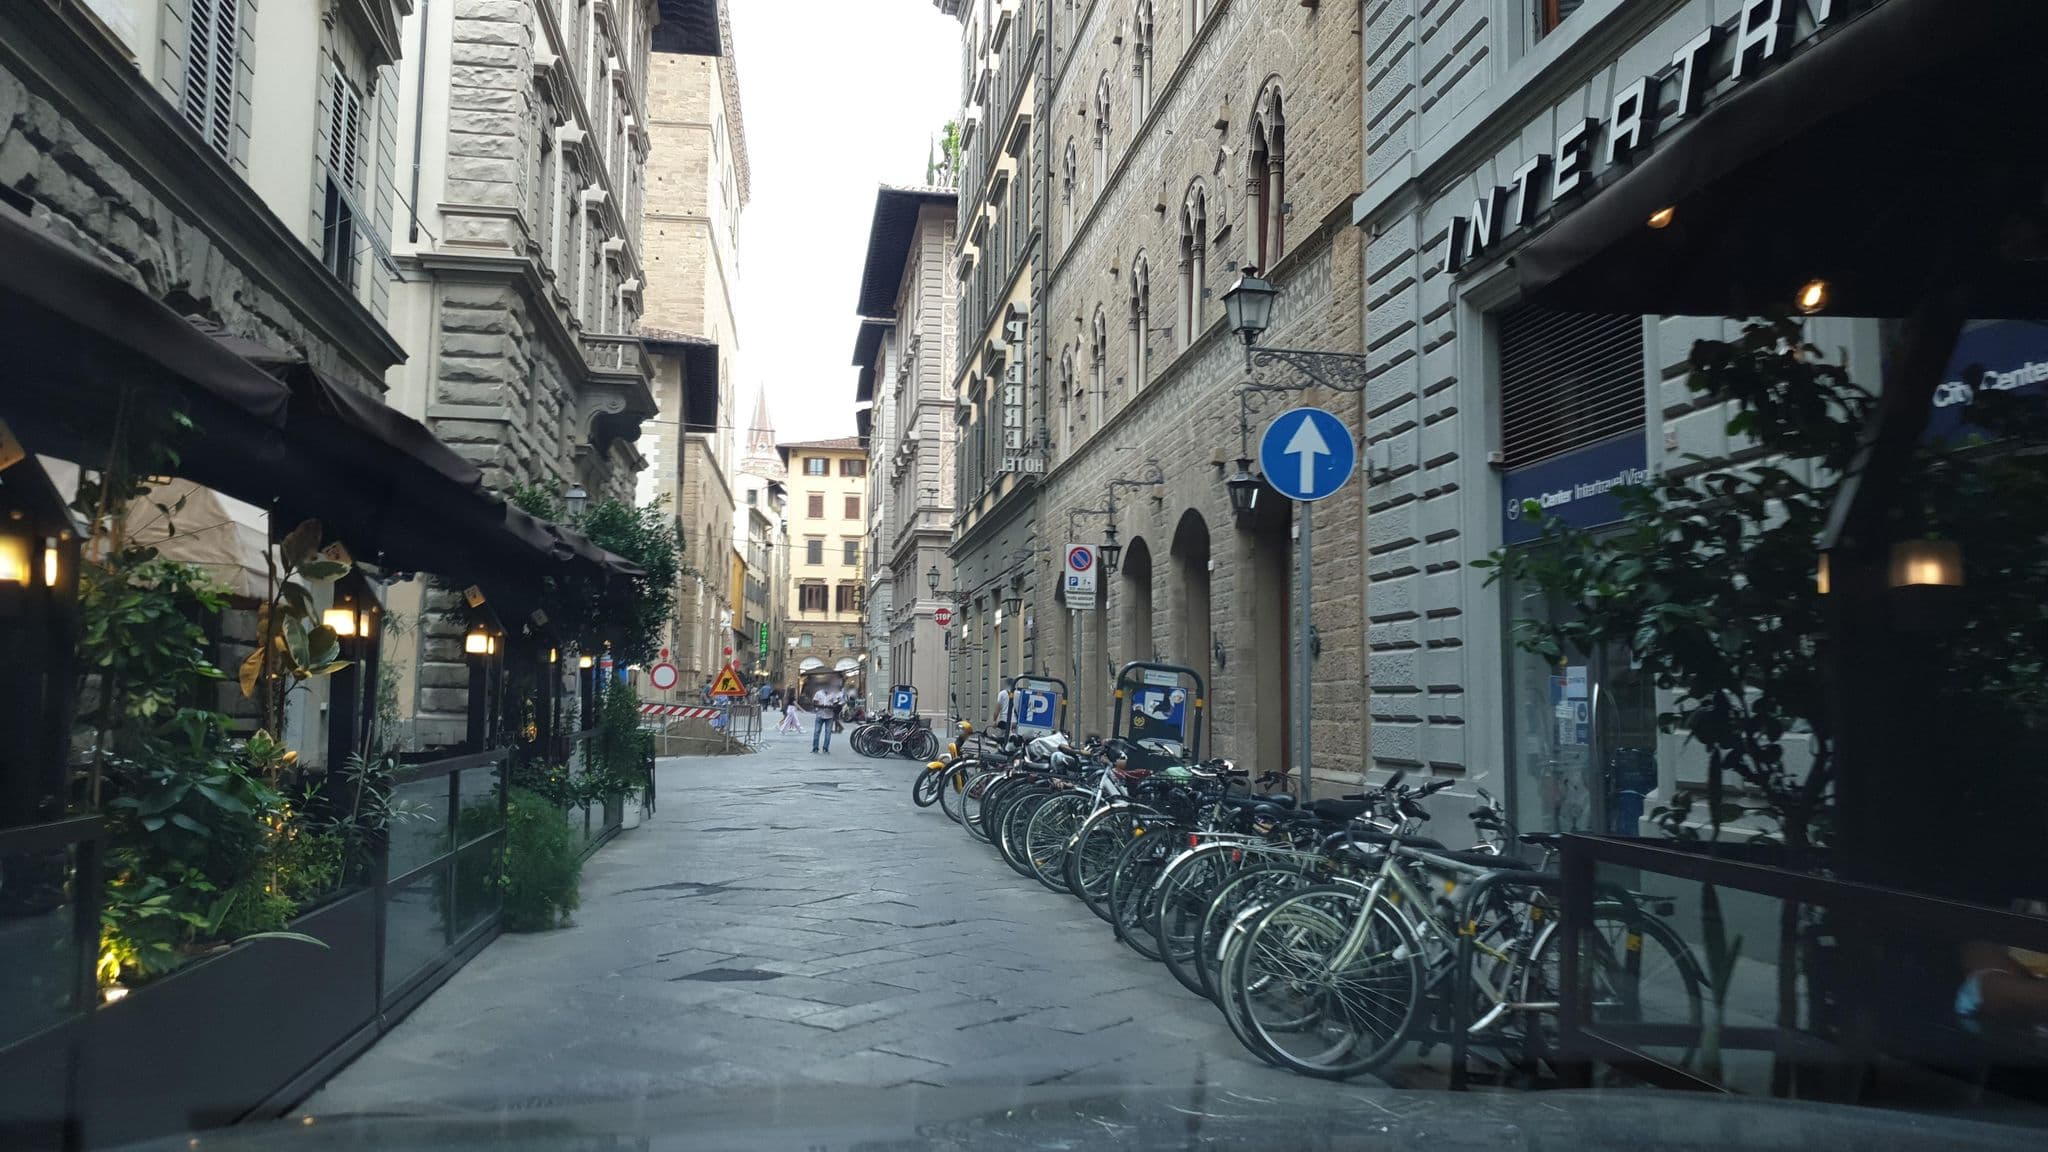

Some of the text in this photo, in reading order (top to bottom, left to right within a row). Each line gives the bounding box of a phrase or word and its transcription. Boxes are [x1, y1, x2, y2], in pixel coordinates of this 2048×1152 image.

[1444, 0, 1832, 273] INTERTR
[935, 613, 951, 621] STOP
[897, 693, 909, 708] P
[1026, 694, 1049, 721] P
